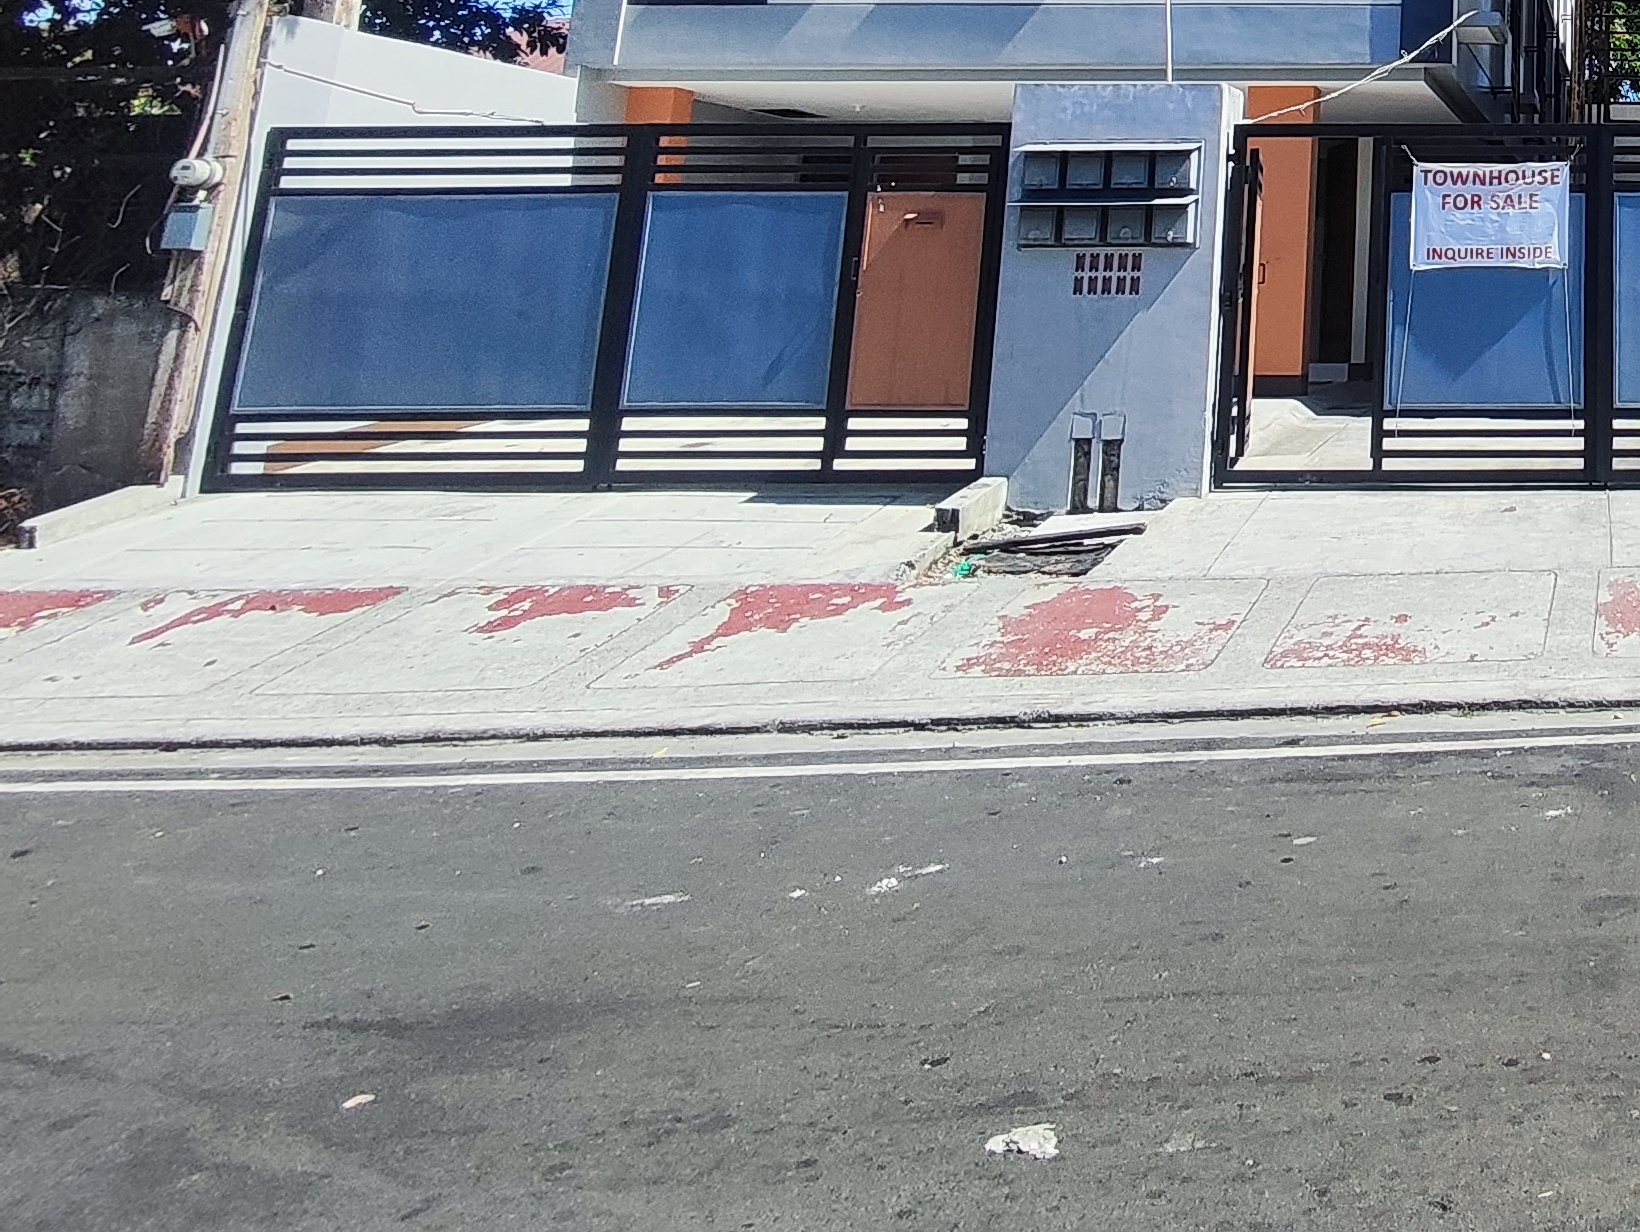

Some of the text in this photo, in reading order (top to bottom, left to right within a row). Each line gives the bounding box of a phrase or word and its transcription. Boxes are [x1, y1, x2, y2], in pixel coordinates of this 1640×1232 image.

[1420, 169, 1561, 186] TOWNHOUSE
[1441, 193, 1539, 211] FOR SALE
[1426, 246, 1553, 262] INQUIRE INSIDE
